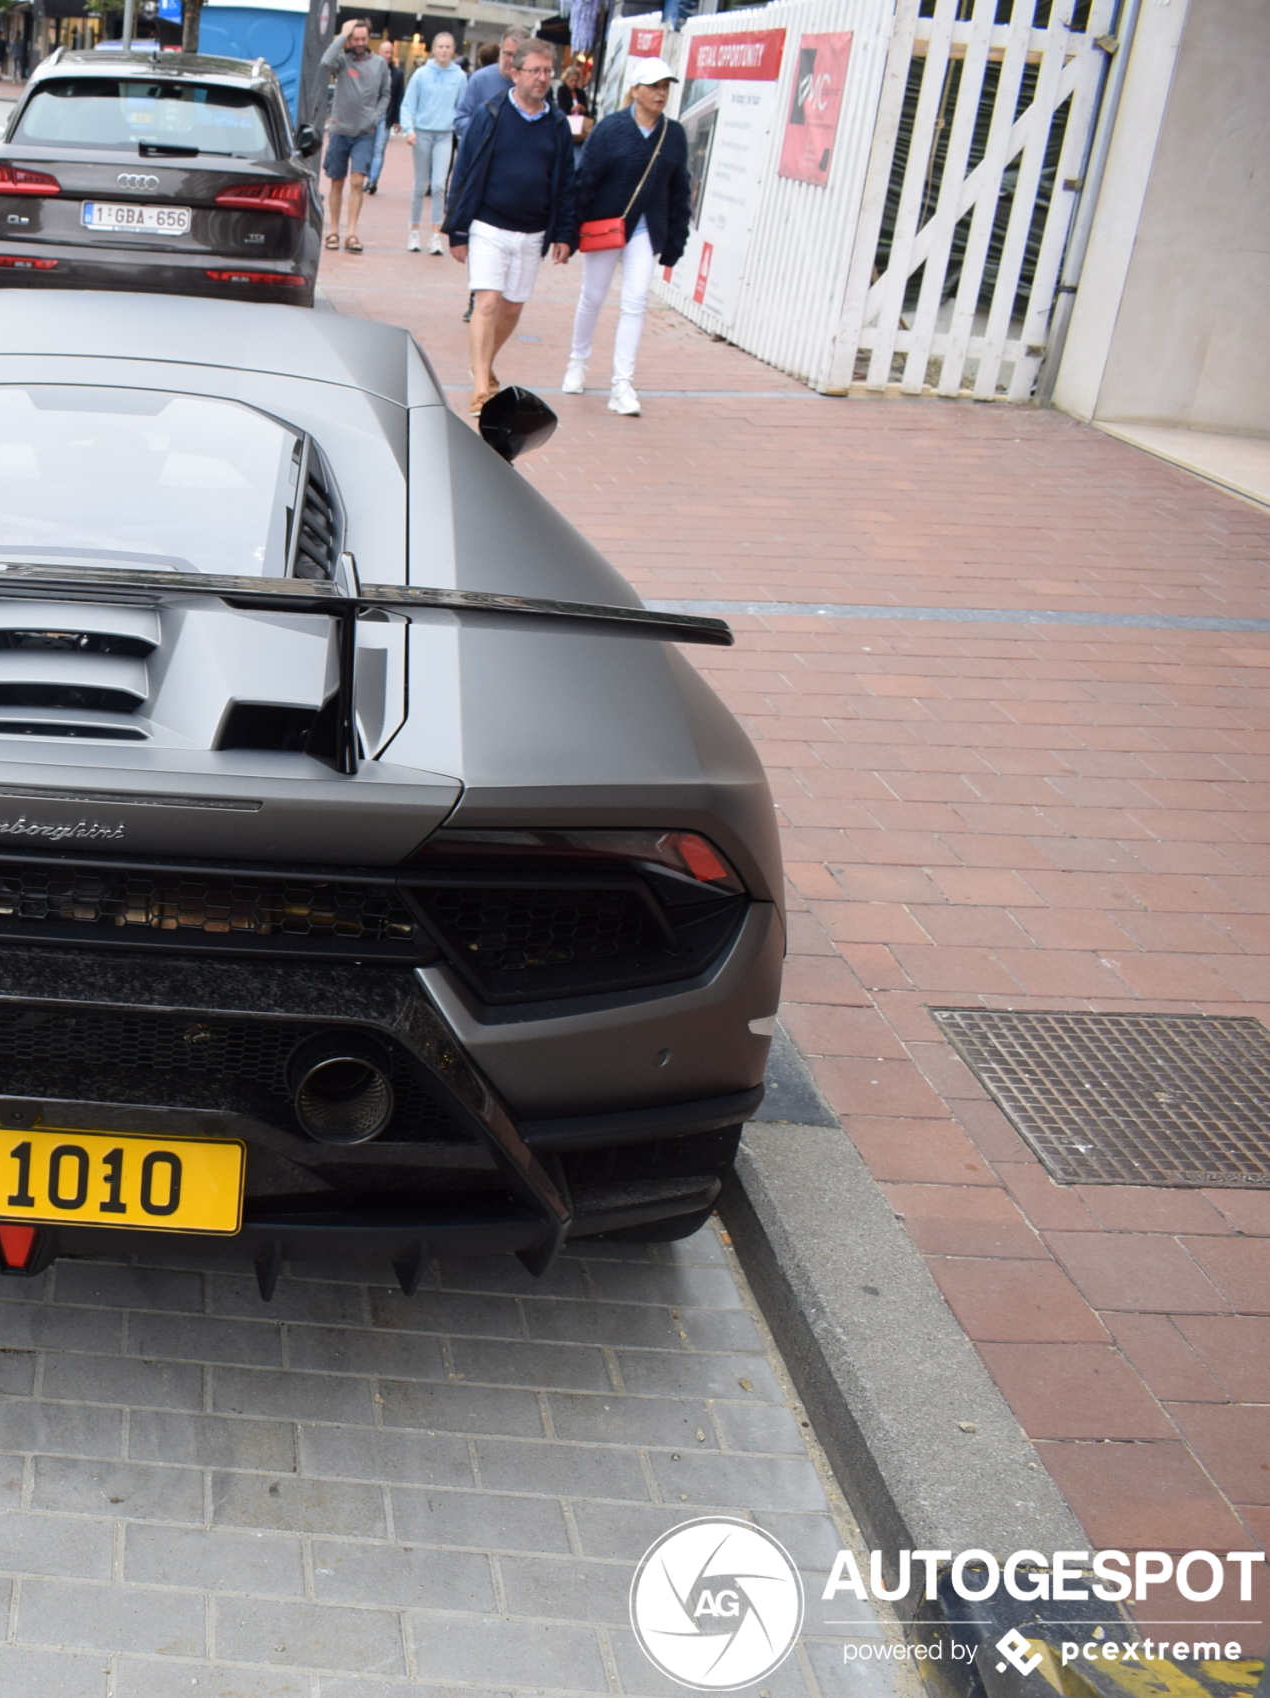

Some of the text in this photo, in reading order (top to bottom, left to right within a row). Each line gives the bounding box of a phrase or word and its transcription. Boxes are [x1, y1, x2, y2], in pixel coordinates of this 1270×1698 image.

[696, 43, 766, 67] RETAIL OPPORTUNITY
[96, 206, 187, 227] 1-GBA-656
[7, 1141, 183, 1216] 1010
